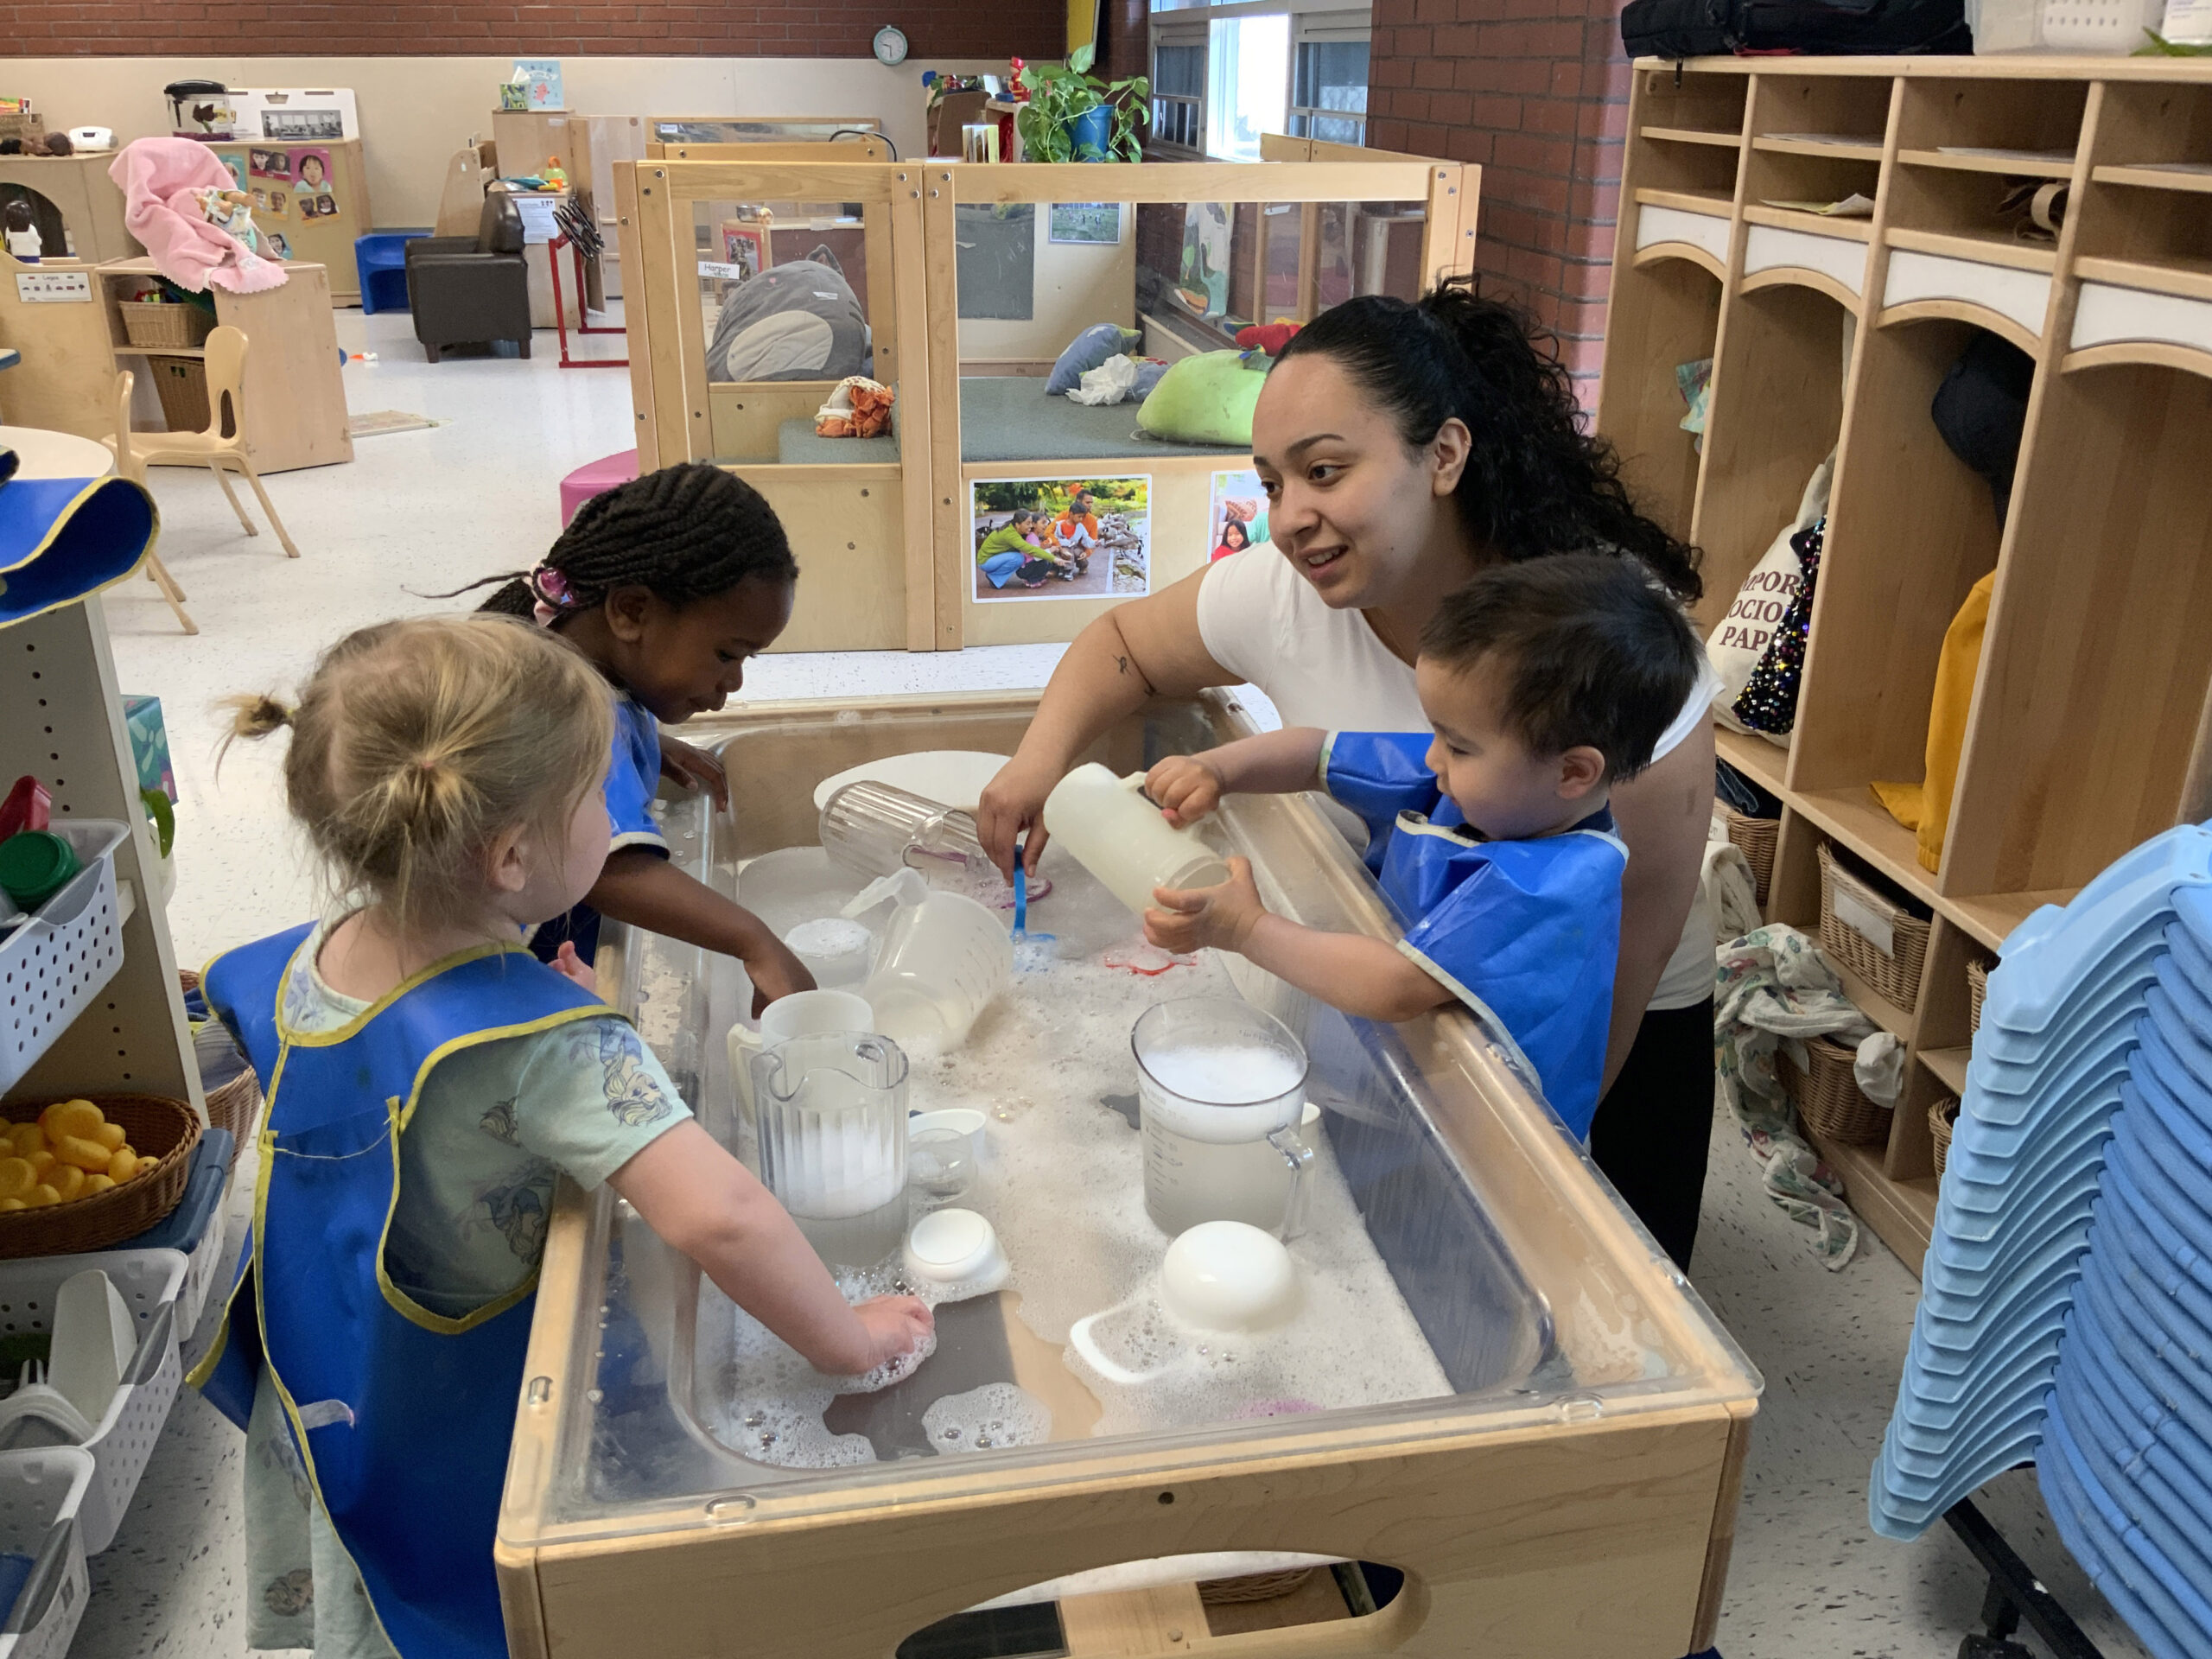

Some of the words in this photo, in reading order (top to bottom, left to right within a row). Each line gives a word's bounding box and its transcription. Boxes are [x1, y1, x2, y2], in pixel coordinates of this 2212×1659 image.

[704, 264, 731, 275] Harper
[1728, 599, 1790, 623] OCIO
[1719, 626, 1776, 652] PAP
